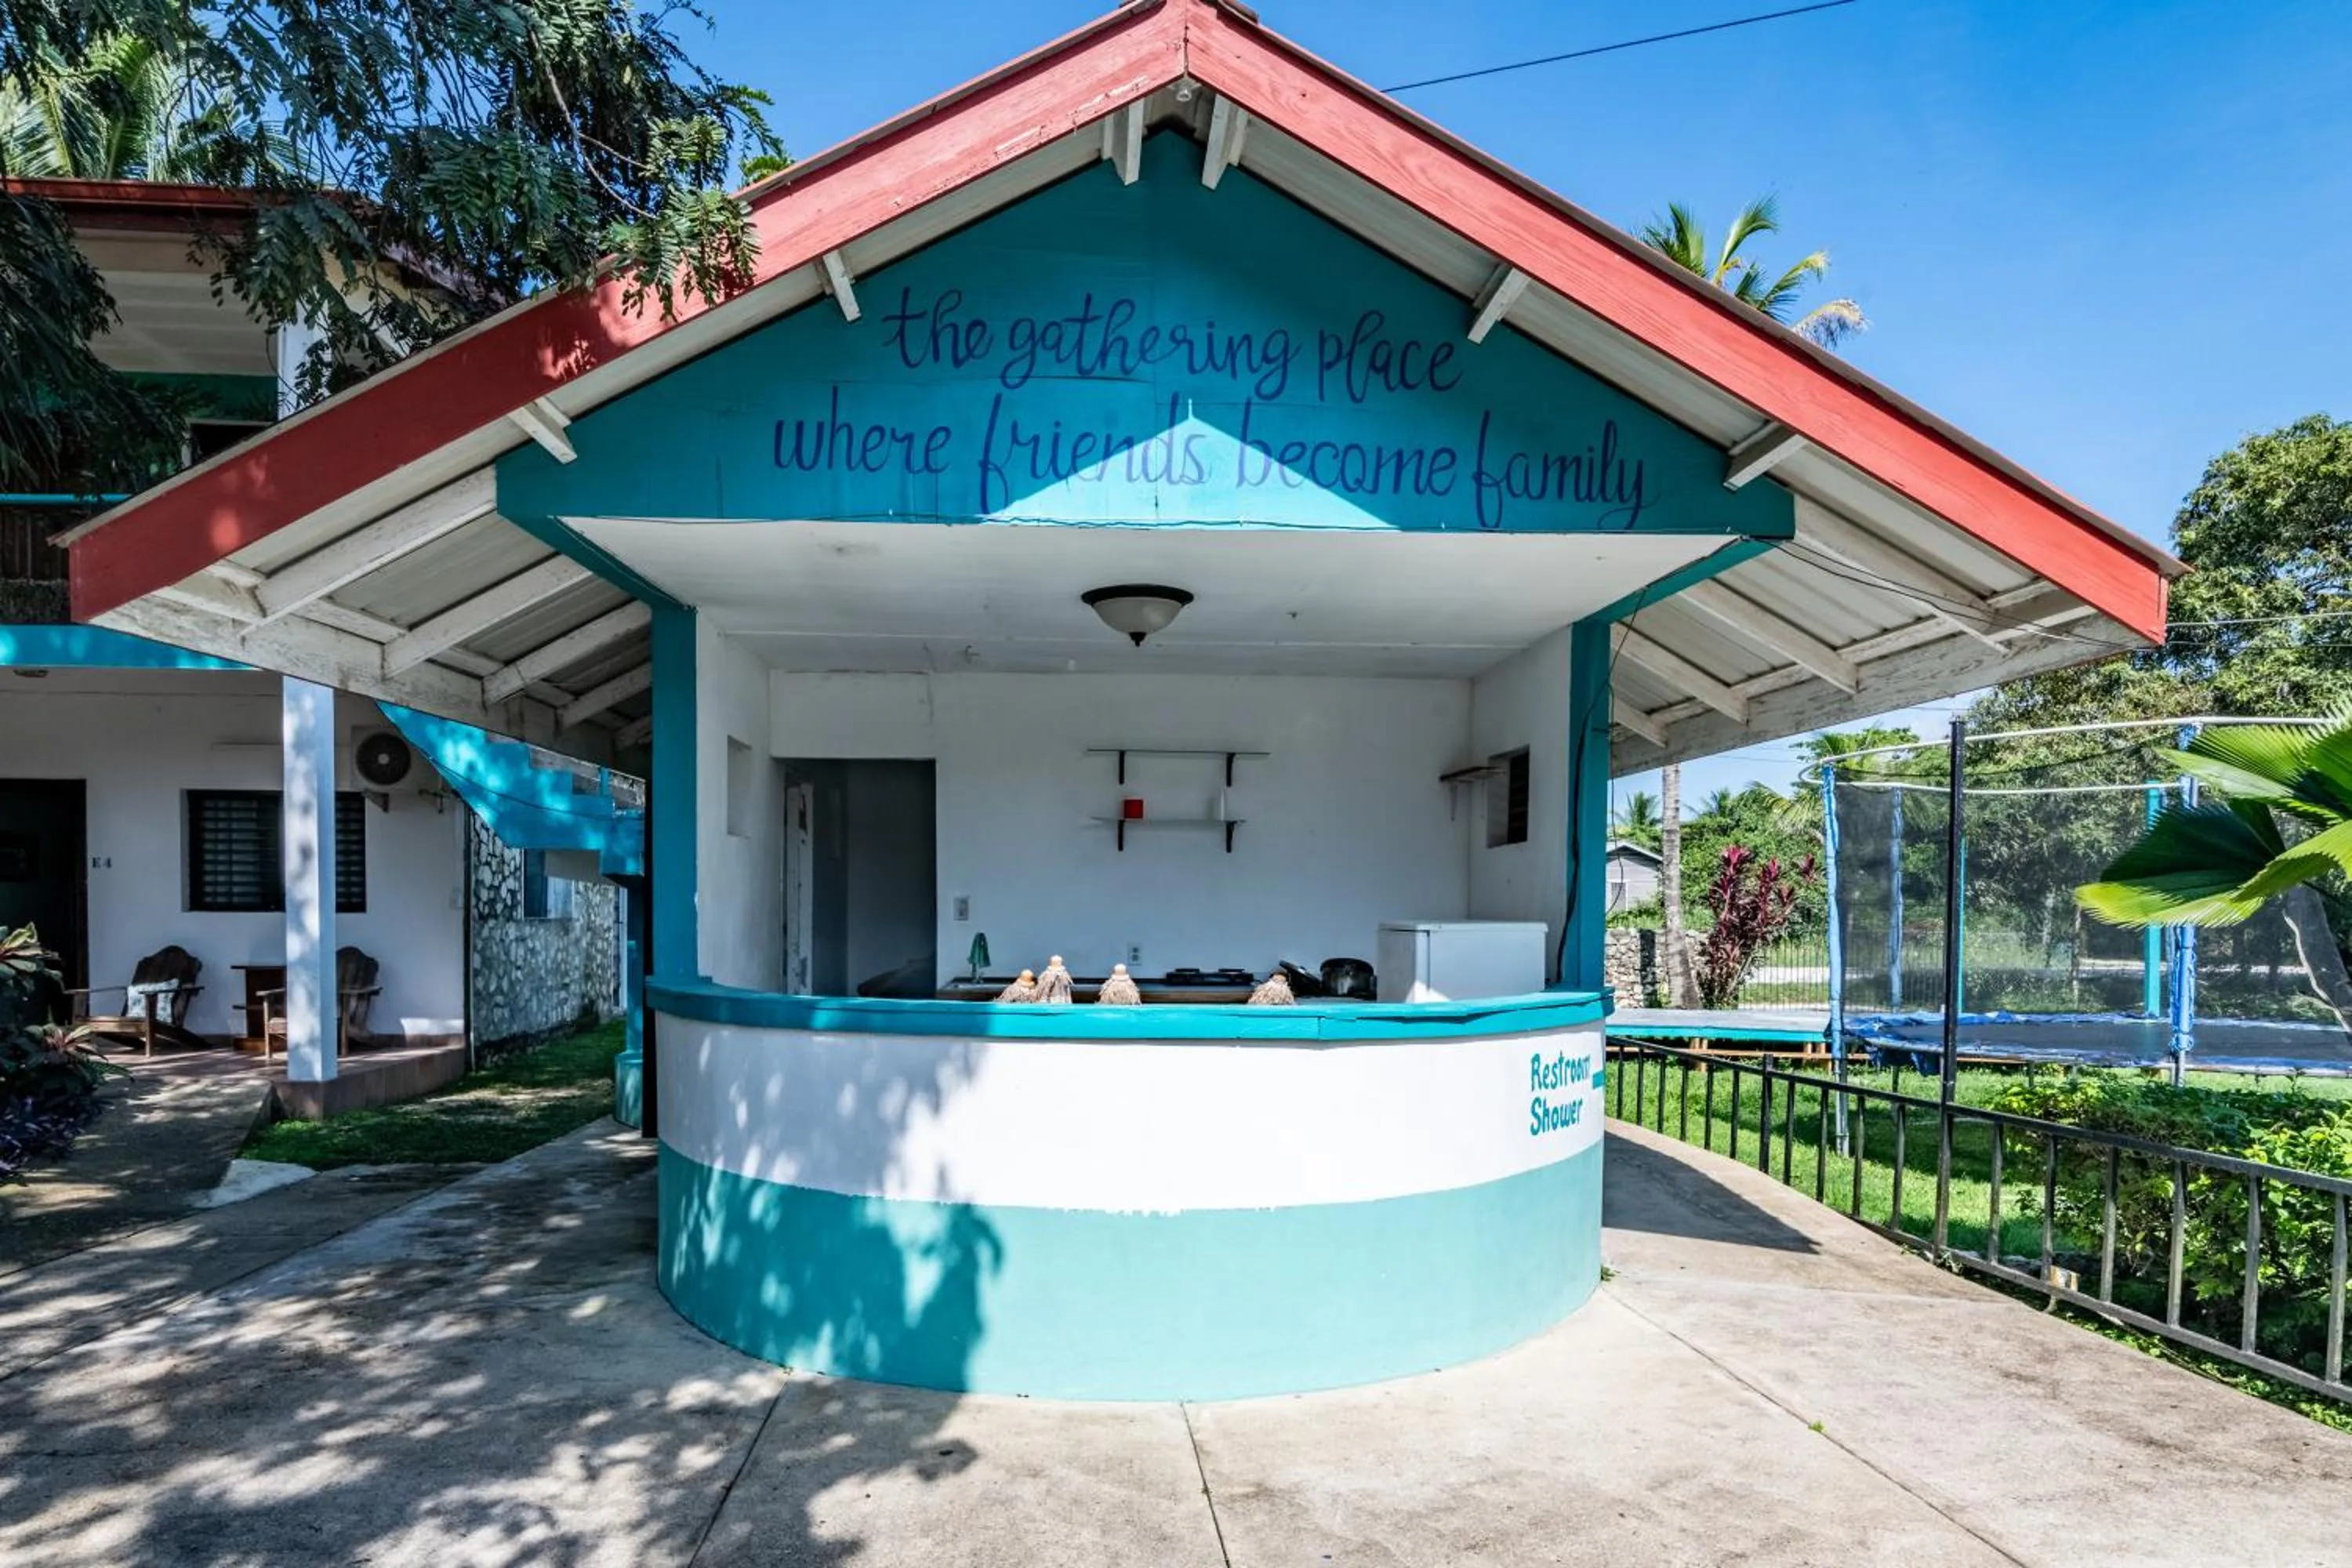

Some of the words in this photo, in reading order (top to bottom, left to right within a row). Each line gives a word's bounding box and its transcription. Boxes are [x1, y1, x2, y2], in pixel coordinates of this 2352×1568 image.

[882, 285, 994, 369] the
[1000, 292, 1302, 401] gathering
[1318, 310, 1465, 404] place
[773, 385, 953, 474] where
[978, 392, 1211, 516] friends
[1236, 395, 1457, 497] become
[1472, 408, 1661, 531] family
[1530, 1050, 1591, 1091] Restroom
[1530, 1095, 1583, 1136] Shower
